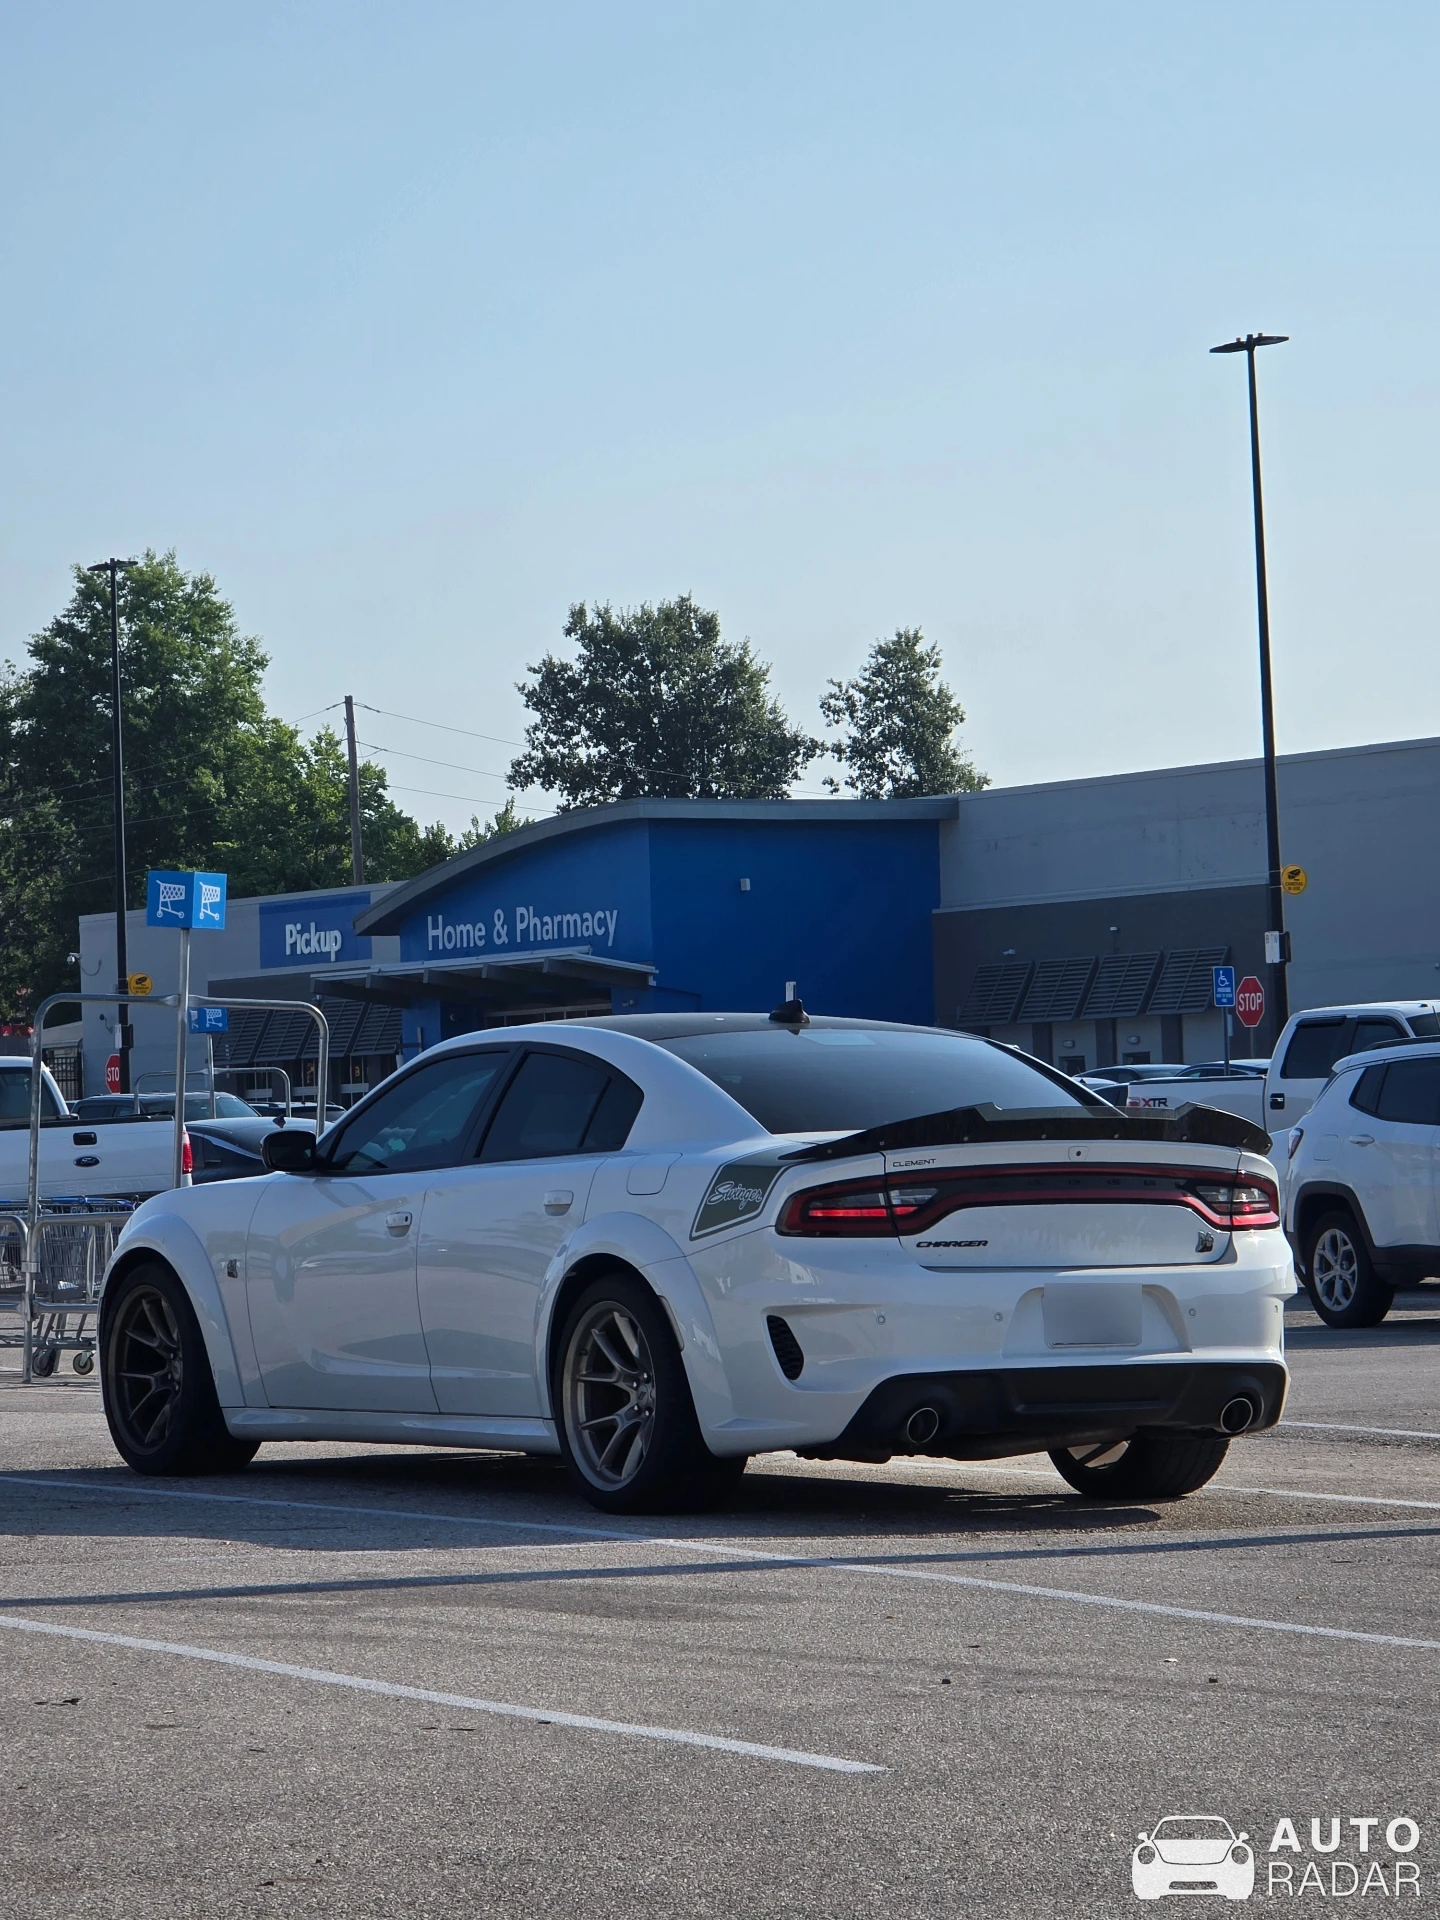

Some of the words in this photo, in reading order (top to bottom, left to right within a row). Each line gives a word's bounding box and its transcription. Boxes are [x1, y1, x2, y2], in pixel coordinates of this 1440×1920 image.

[427, 914, 486, 951] Home
[493, 908, 509, 945] &
[515, 905, 618, 947] Pharmacy
[285, 921, 342, 962] Pickup
[1238, 992, 1263, 1011] STOP
[107, 1066, 120, 1082] STO
[1141, 1097, 1169, 1107] XTR
[892, 1158, 937, 1168] CLEMENT
[707, 1180, 762, 1210] Swinger
[916, 1239, 988, 1248] CHARGER
